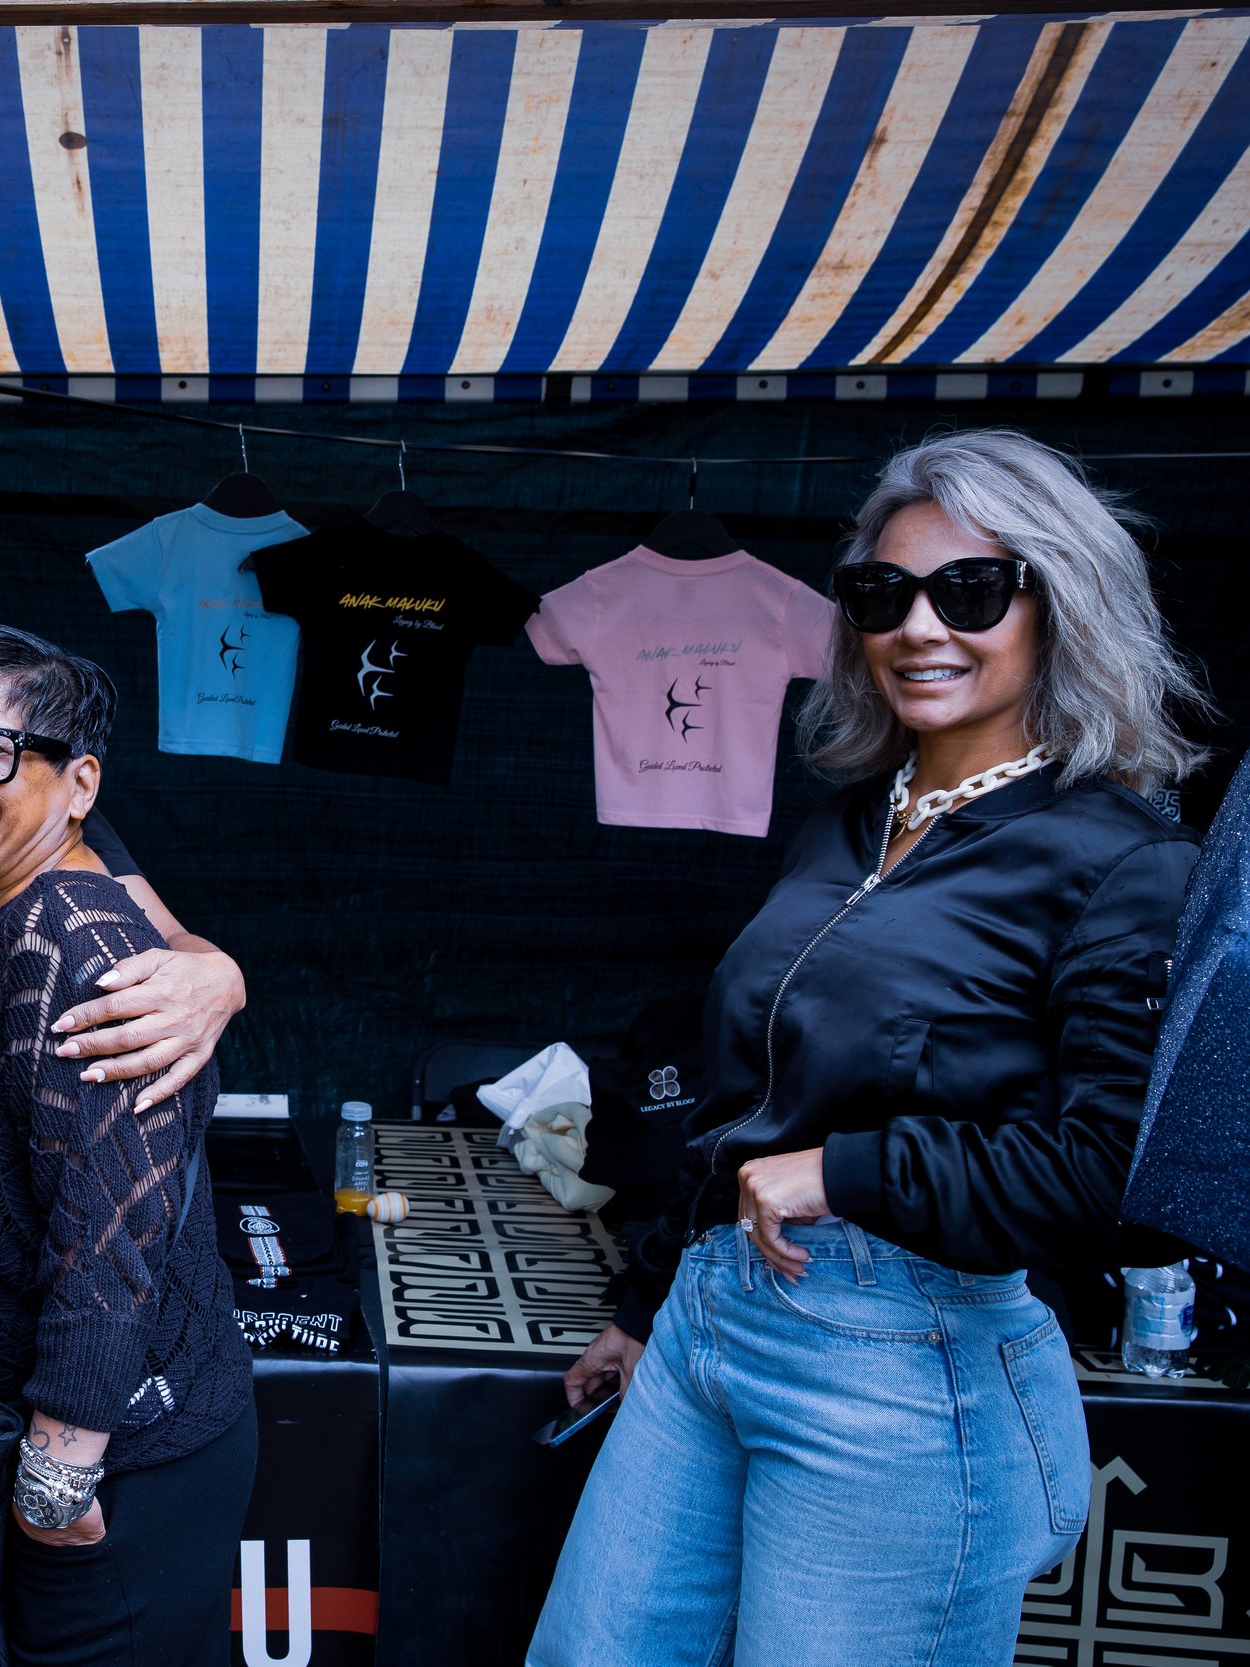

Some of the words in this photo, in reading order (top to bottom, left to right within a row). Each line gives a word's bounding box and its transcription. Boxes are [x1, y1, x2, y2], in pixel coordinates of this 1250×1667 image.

[339, 592, 385, 609] ANAK
[385, 597, 446, 612] MALUKU
[636, 645, 681, 662] ANAK
[682, 640, 743, 656] MALUKU
[638, 759, 664, 773] Guided
[663, 760, 688, 773] Loved
[688, 761, 723, 773] Protected
[640, 1103, 666, 1113] LEGACY
[666, 1100, 676, 1109] BY
